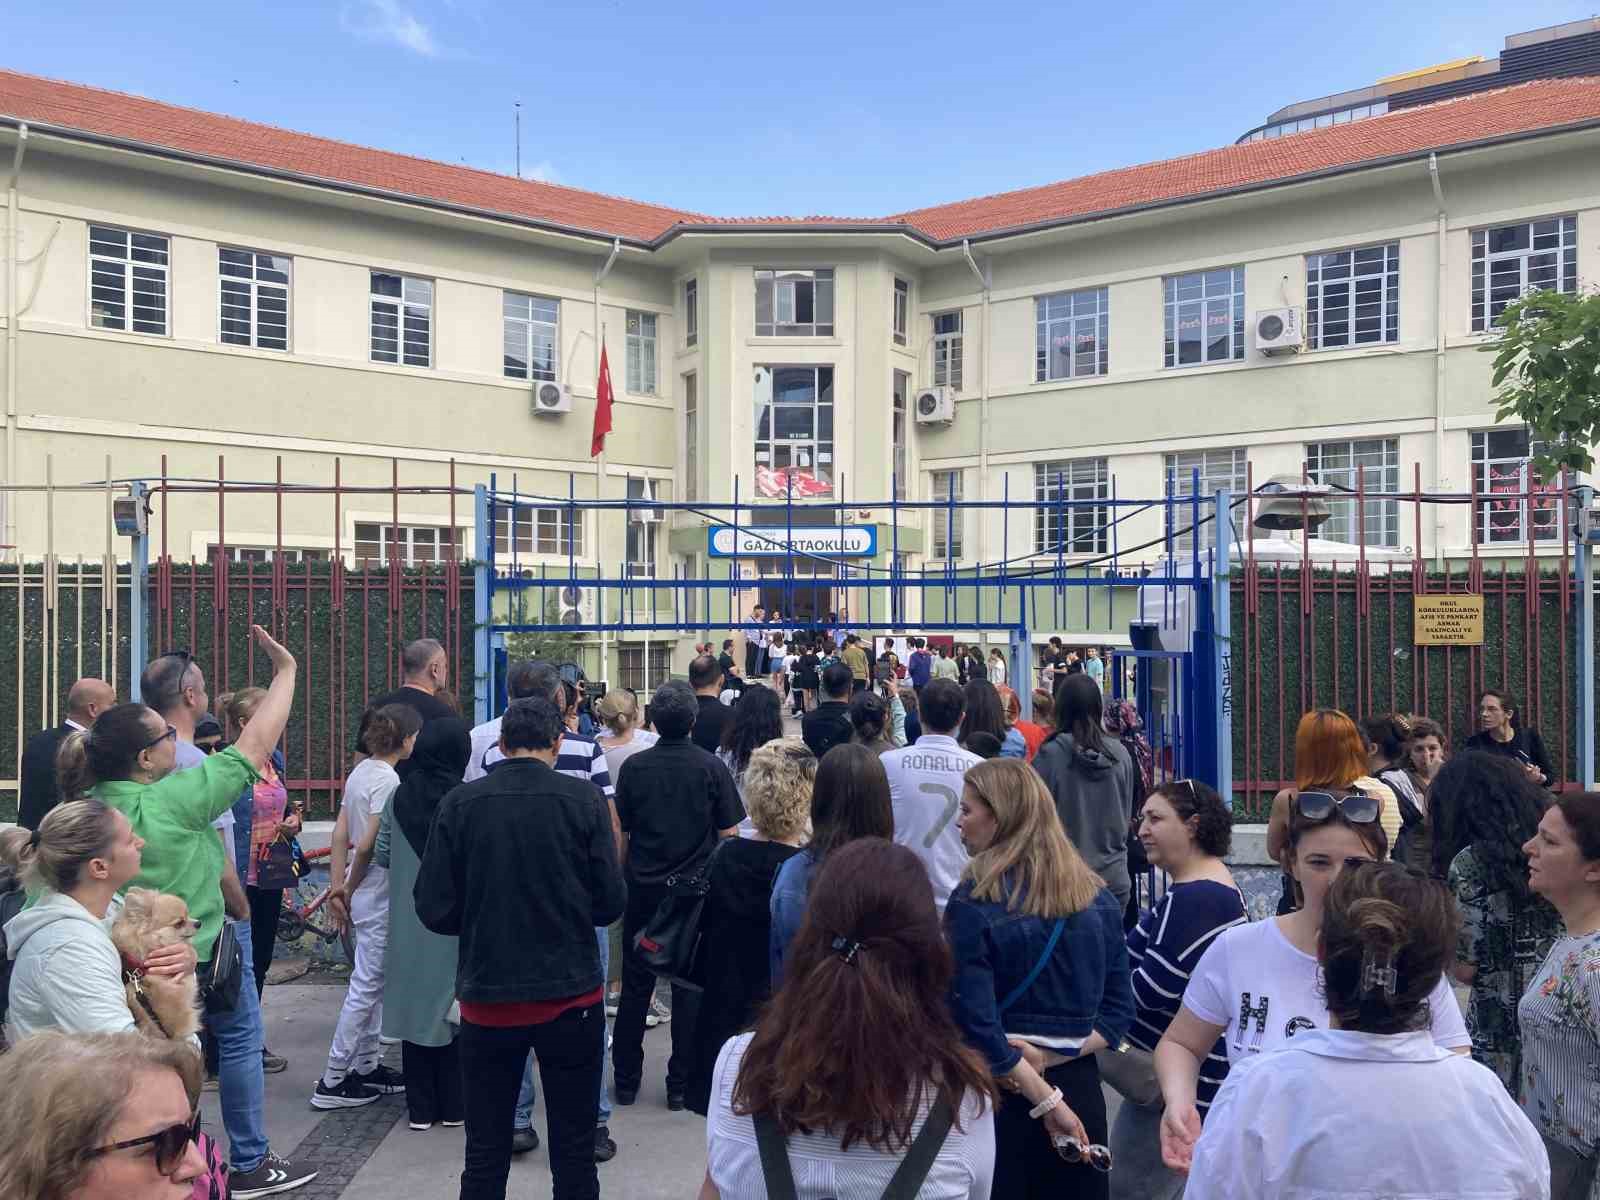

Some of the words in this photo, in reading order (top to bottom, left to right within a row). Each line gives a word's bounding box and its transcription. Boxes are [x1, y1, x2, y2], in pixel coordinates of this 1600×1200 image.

[743, 538, 777, 551] GAZİ
[780, 539, 861, 551] ORTAOKULU
[918, 782, 959, 848] 7
